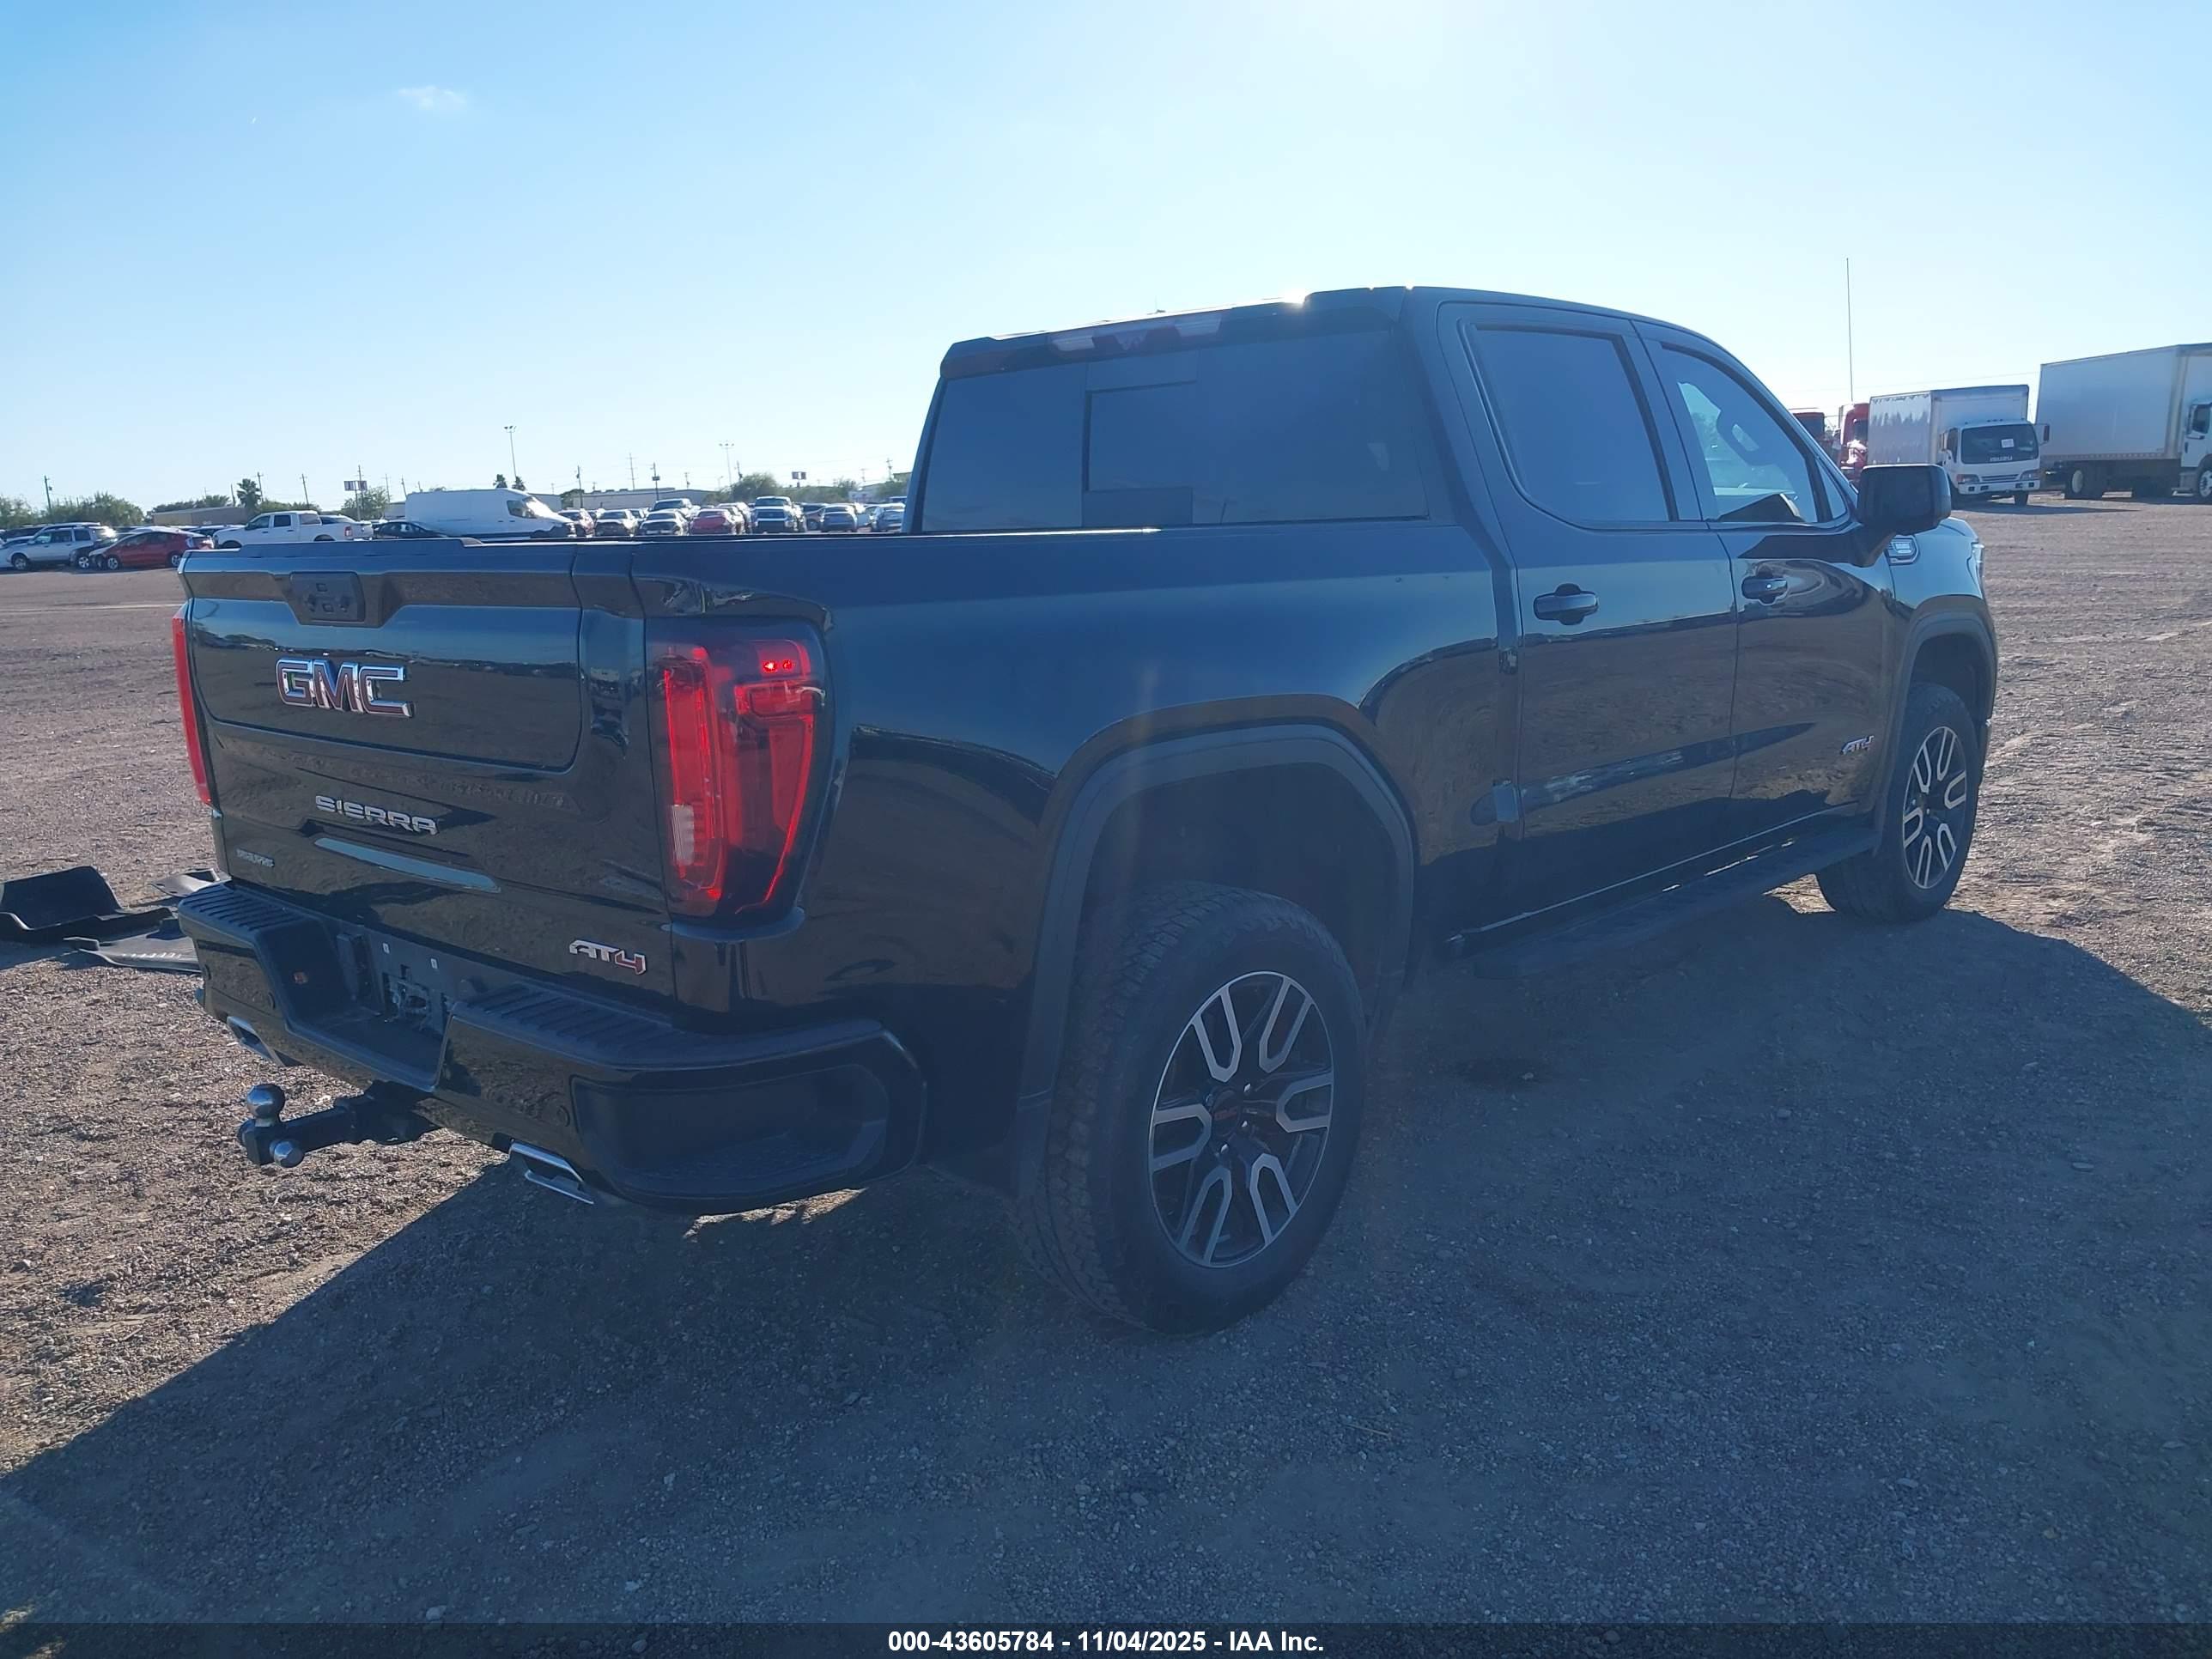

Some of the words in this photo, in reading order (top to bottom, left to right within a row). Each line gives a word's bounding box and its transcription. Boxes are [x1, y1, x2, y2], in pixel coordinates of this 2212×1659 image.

[276, 657, 414, 717] GMC
[315, 795, 440, 836] SIERRA
[568, 939, 647, 975] AT4
